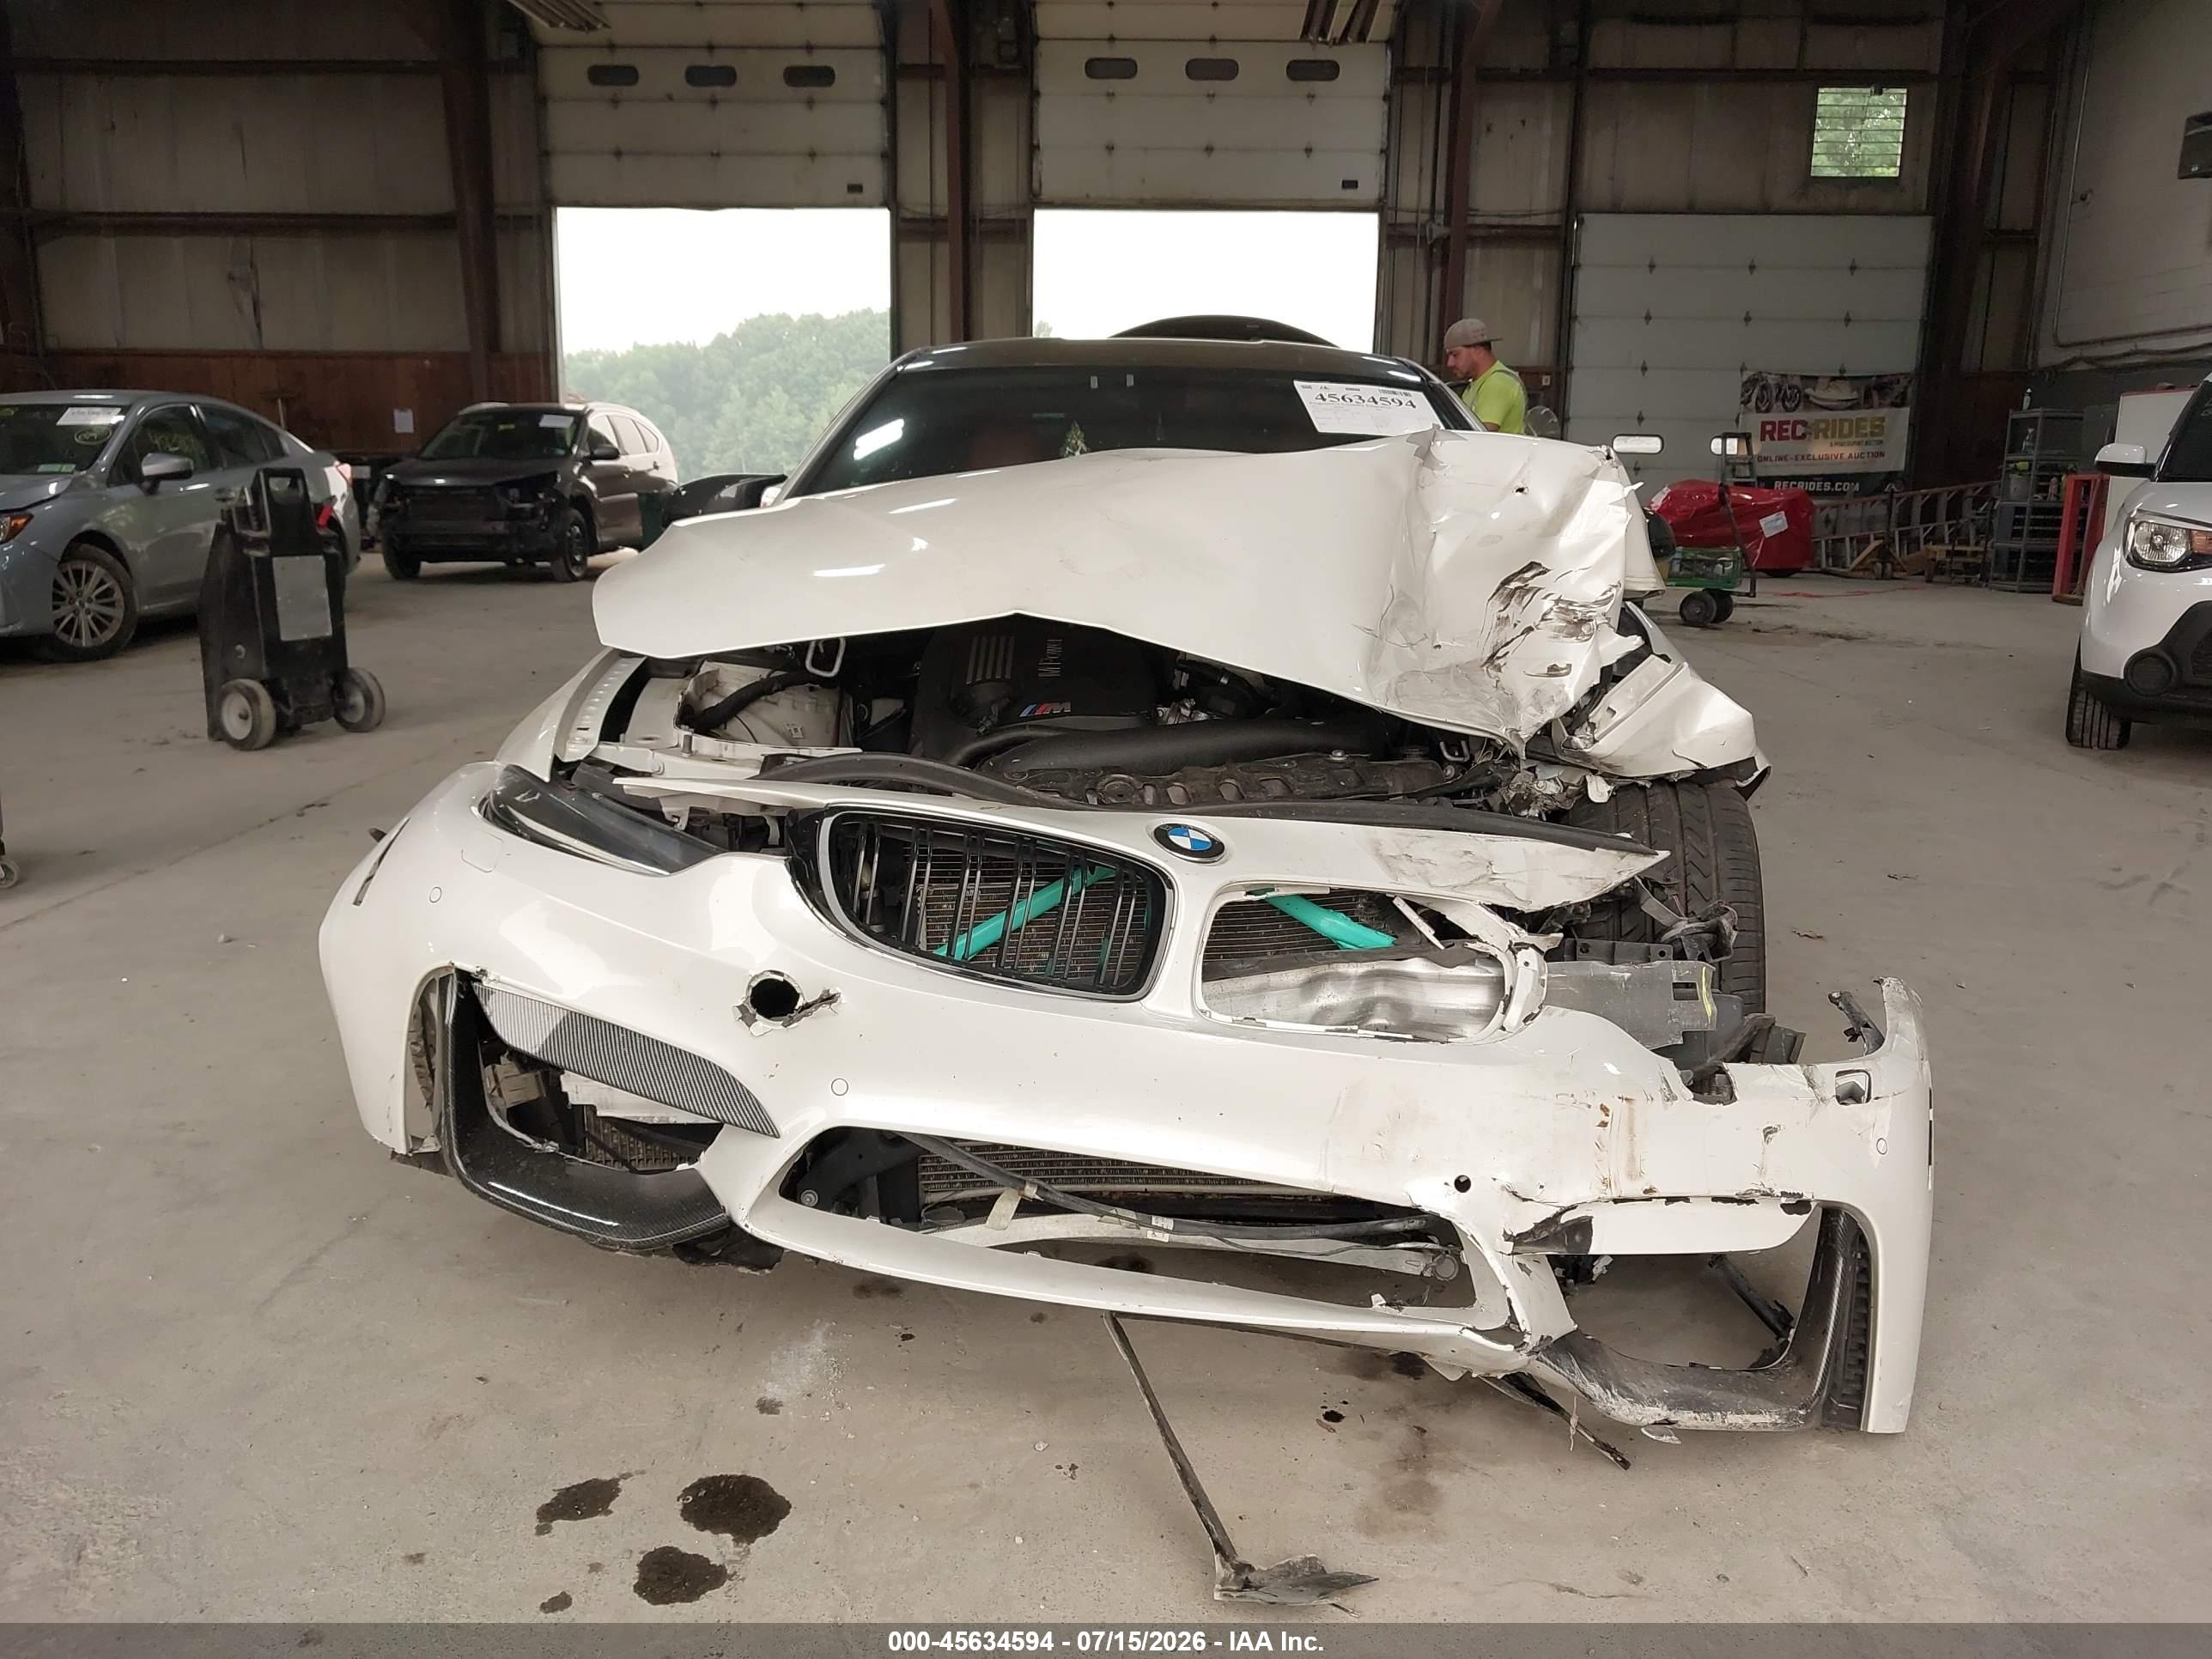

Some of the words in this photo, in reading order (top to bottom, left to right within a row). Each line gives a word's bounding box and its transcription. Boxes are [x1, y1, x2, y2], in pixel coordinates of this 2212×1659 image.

[1315, 392, 1417, 410] 45634594
[1757, 453, 1844, 464] ONLINE-EXCLUSIVE
[1847, 452, 1886, 460] AUCTION
